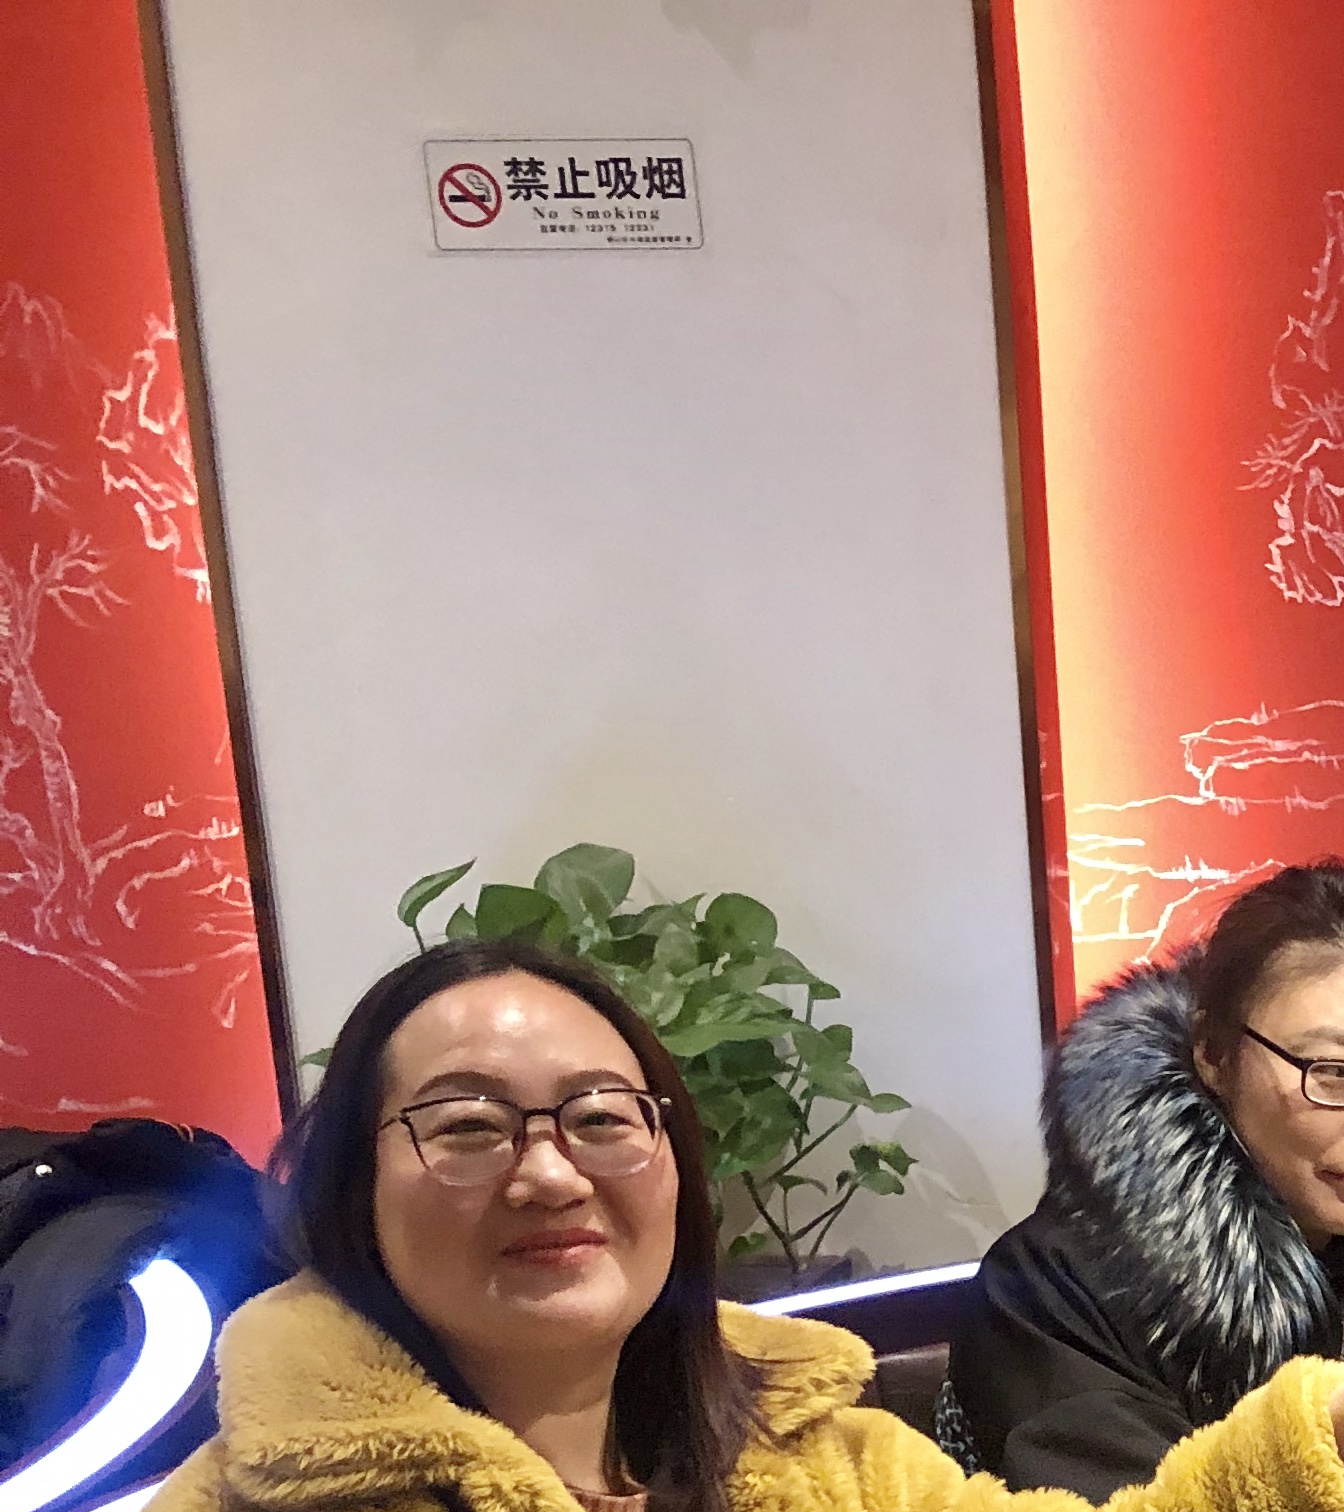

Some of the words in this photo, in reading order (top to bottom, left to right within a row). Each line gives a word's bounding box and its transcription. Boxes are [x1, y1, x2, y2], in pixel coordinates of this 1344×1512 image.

[503, 156, 686, 201] 禁止吸烟
[532, 207, 558, 220] No
[572, 205, 660, 221] Smoking
